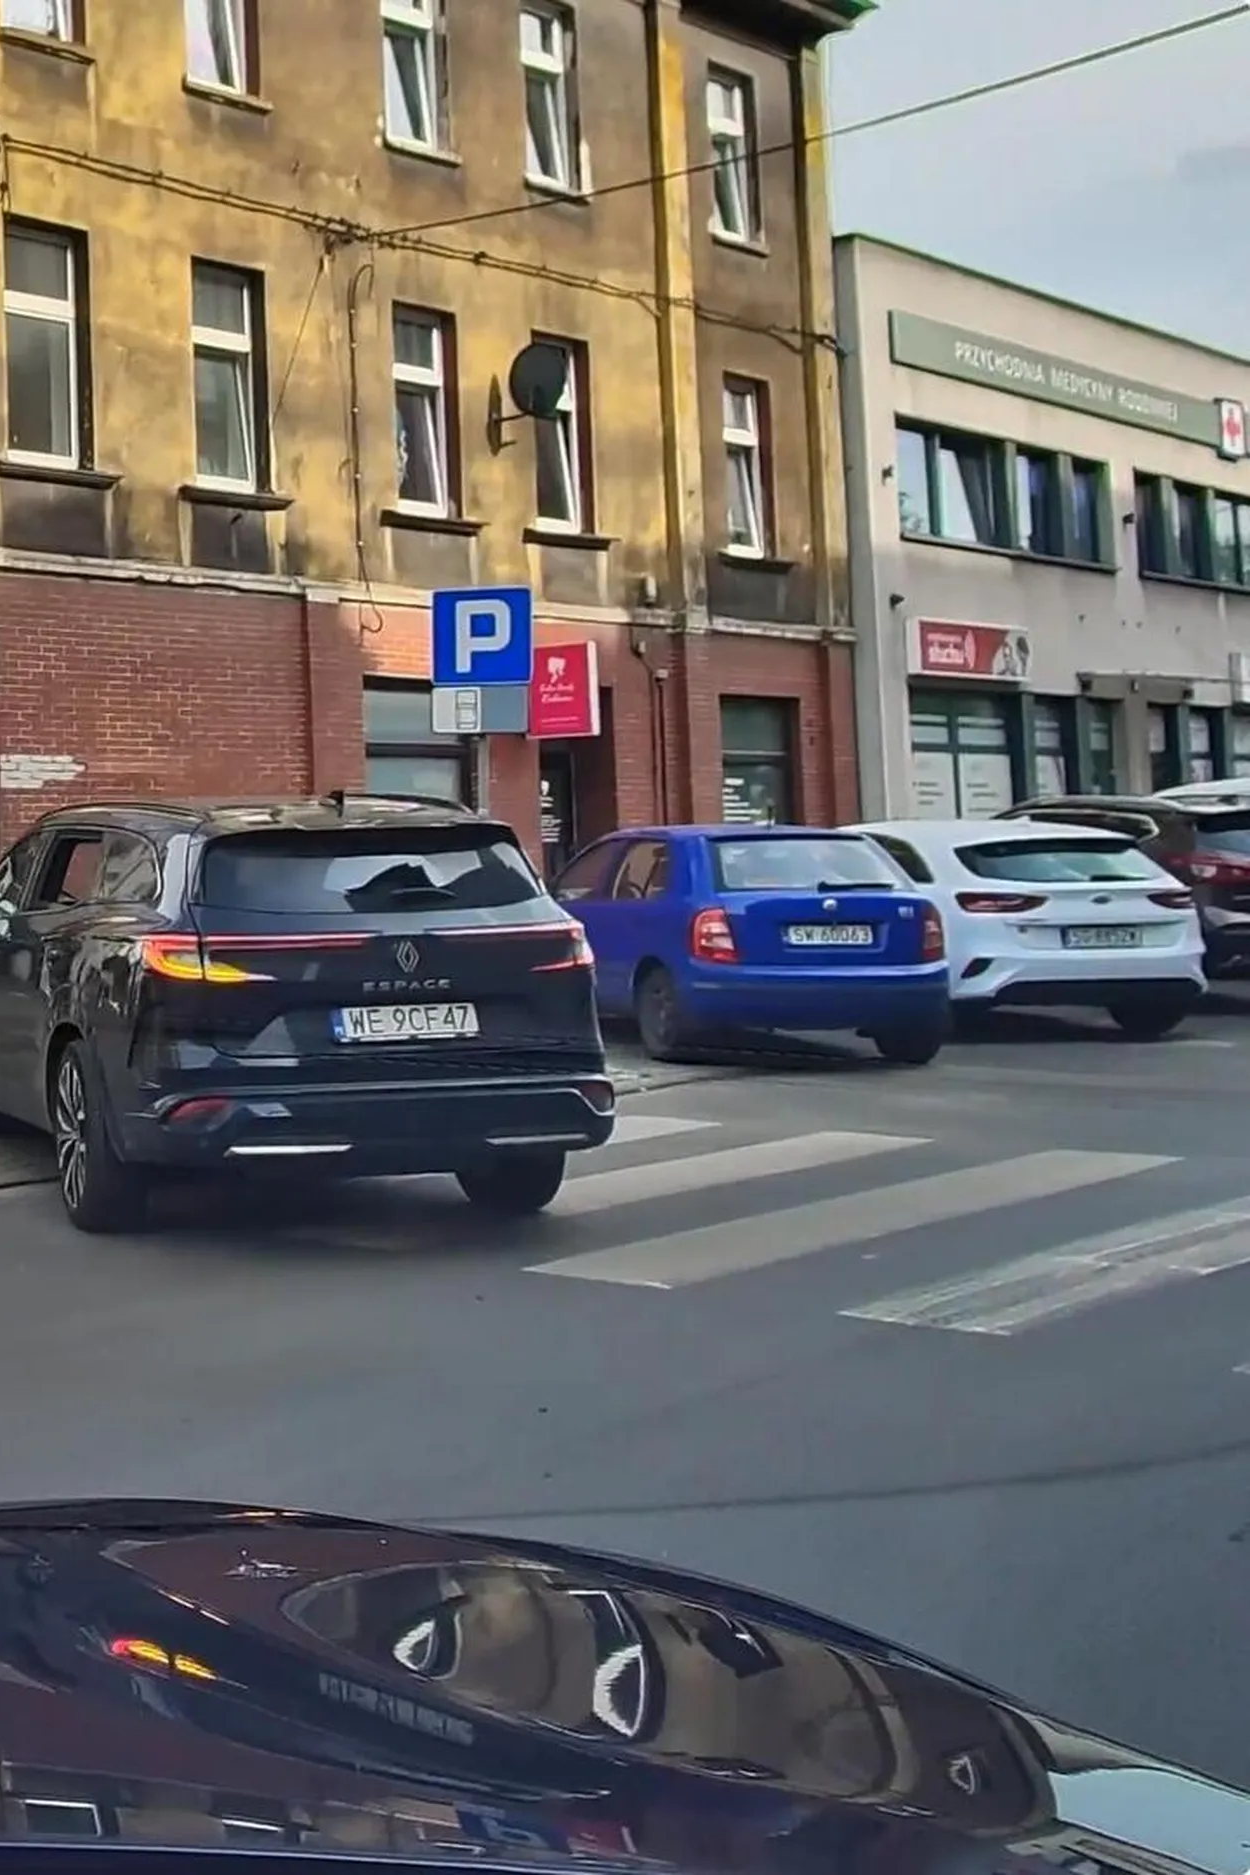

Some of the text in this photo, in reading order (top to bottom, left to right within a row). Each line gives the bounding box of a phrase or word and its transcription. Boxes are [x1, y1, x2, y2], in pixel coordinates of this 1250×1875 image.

[954, 340, 1046, 385] PRZYCHODNIA
[455, 599, 512, 674] P
[362, 978, 452, 992] ESPACE
[349, 1005, 469, 1034] WE 9CF47
